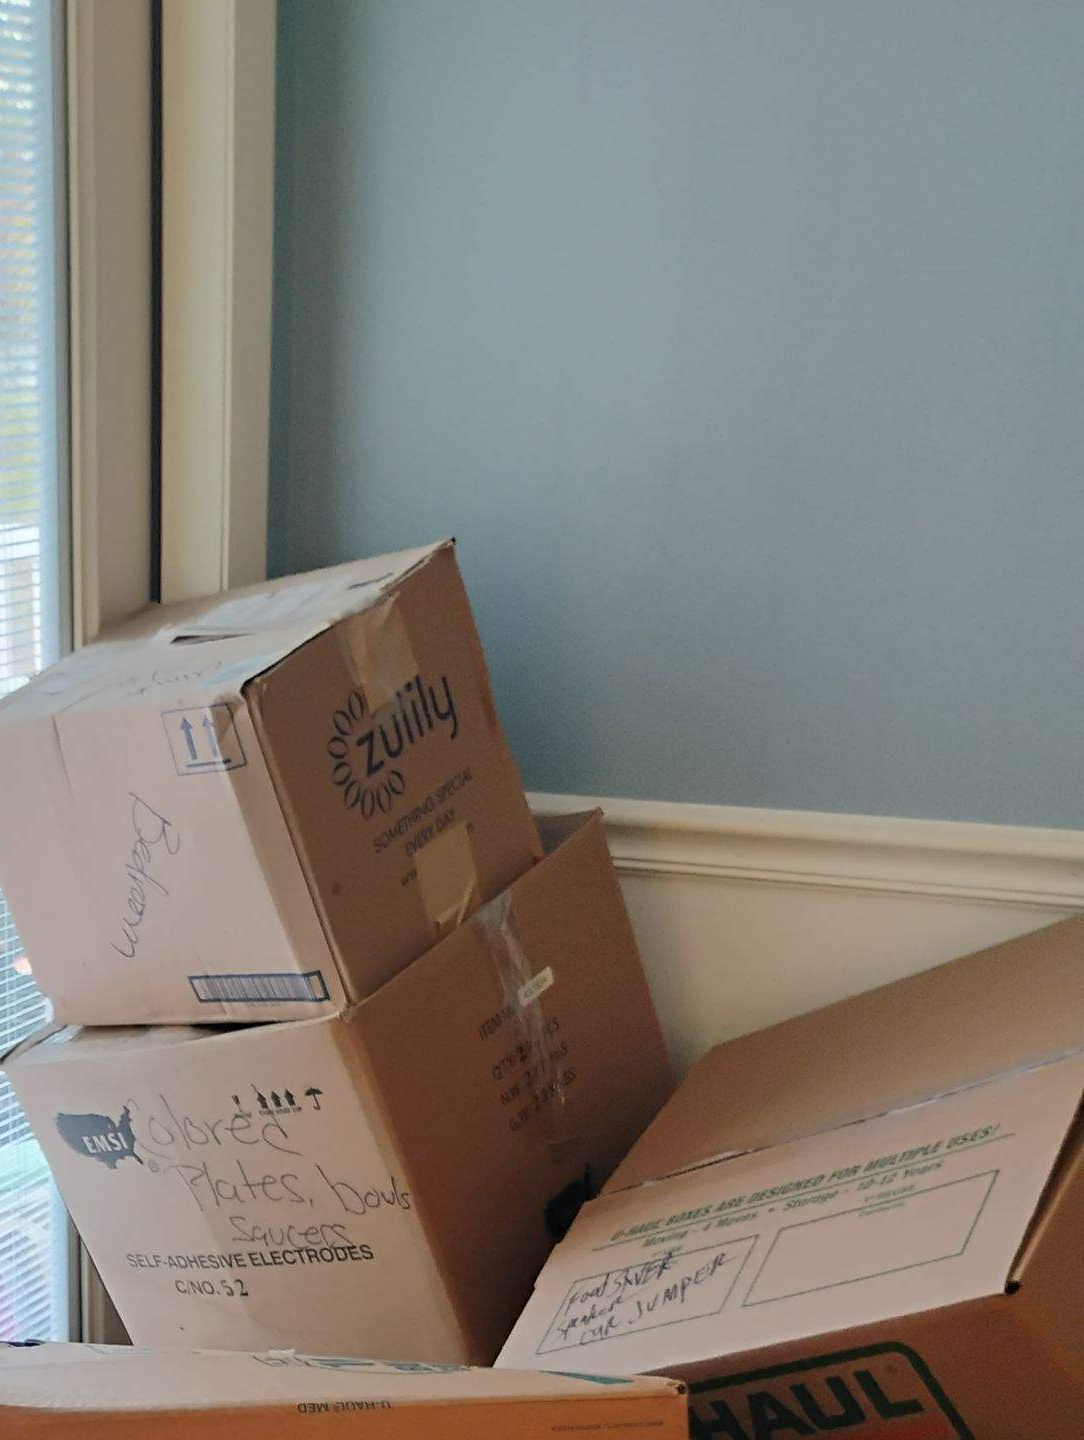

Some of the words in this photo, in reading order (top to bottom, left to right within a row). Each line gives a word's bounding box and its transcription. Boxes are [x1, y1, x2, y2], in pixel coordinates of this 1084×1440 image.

[356, 675, 457, 776] zulily
[373, 795, 434, 852] SOMETHING
[435, 808, 456, 832] DAY
[82, 1132, 127, 1155] EMSI
[123, 1093, 304, 1158] Colored
[747, 1174, 825, 1203] DESIGNED
[827, 1164, 862, 1182] FOR
[863, 1140, 945, 1172] MULTIPLE
[126, 1251, 248, 1270] SELF-ADHESIVE
[249, 1244, 374, 1268] ELECTRODES
[628, 1253, 726, 1324] JUMPER
[297, 1401, 329, 1413] MED
